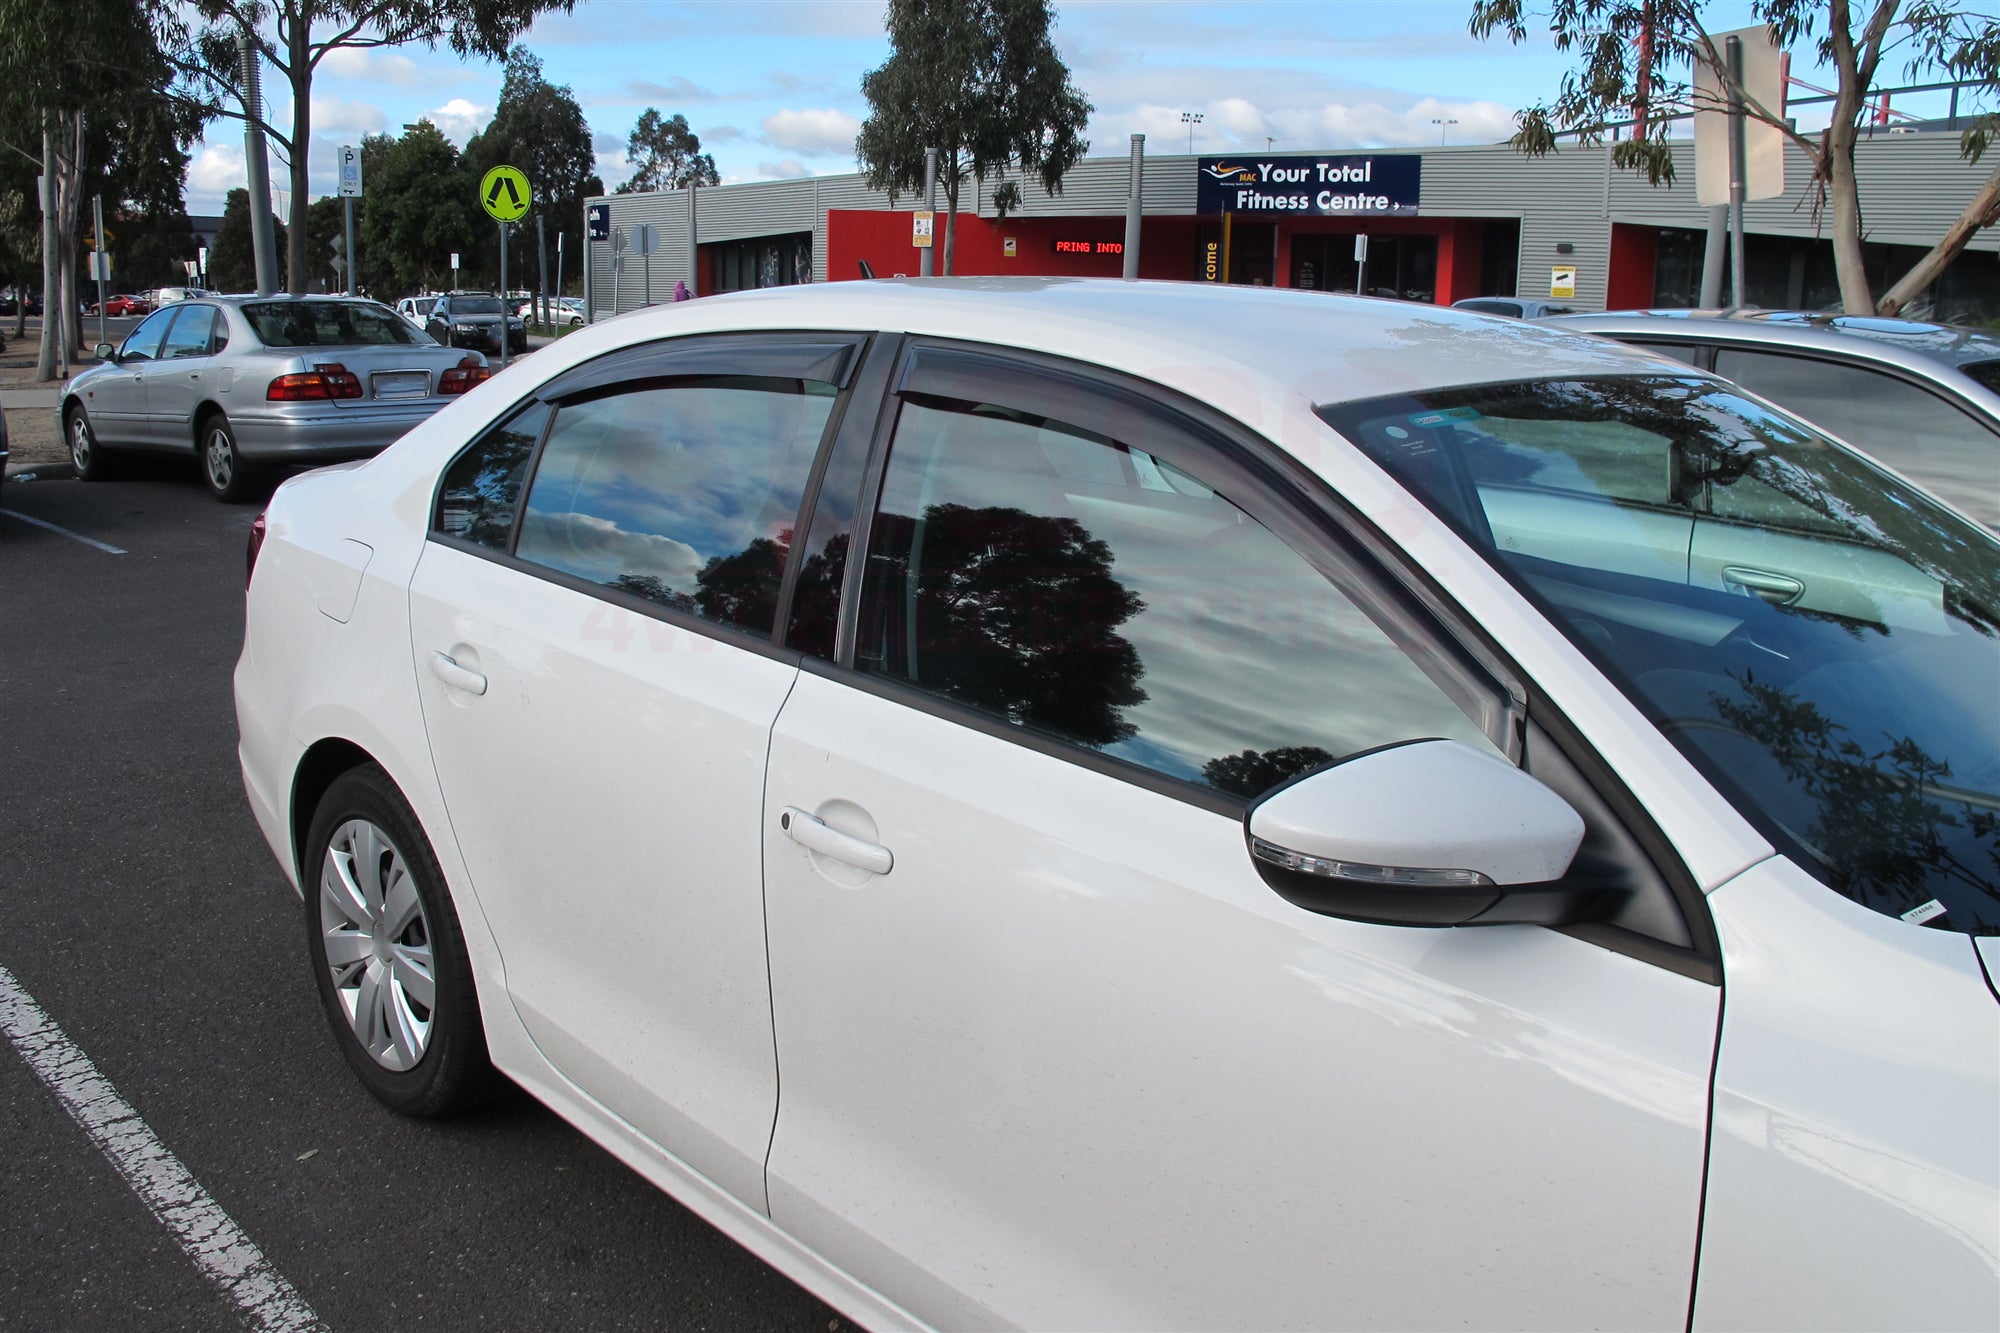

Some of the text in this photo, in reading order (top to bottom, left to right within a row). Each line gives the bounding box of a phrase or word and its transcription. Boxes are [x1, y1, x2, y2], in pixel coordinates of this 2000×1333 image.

[345, 153, 354, 165] P
[1239, 173, 1257, 182] MAC
[1257, 161, 1371, 182] Your Total
[1236, 191, 1389, 210] Fitness Centre
[1056, 241, 1122, 254] PRING INTO
